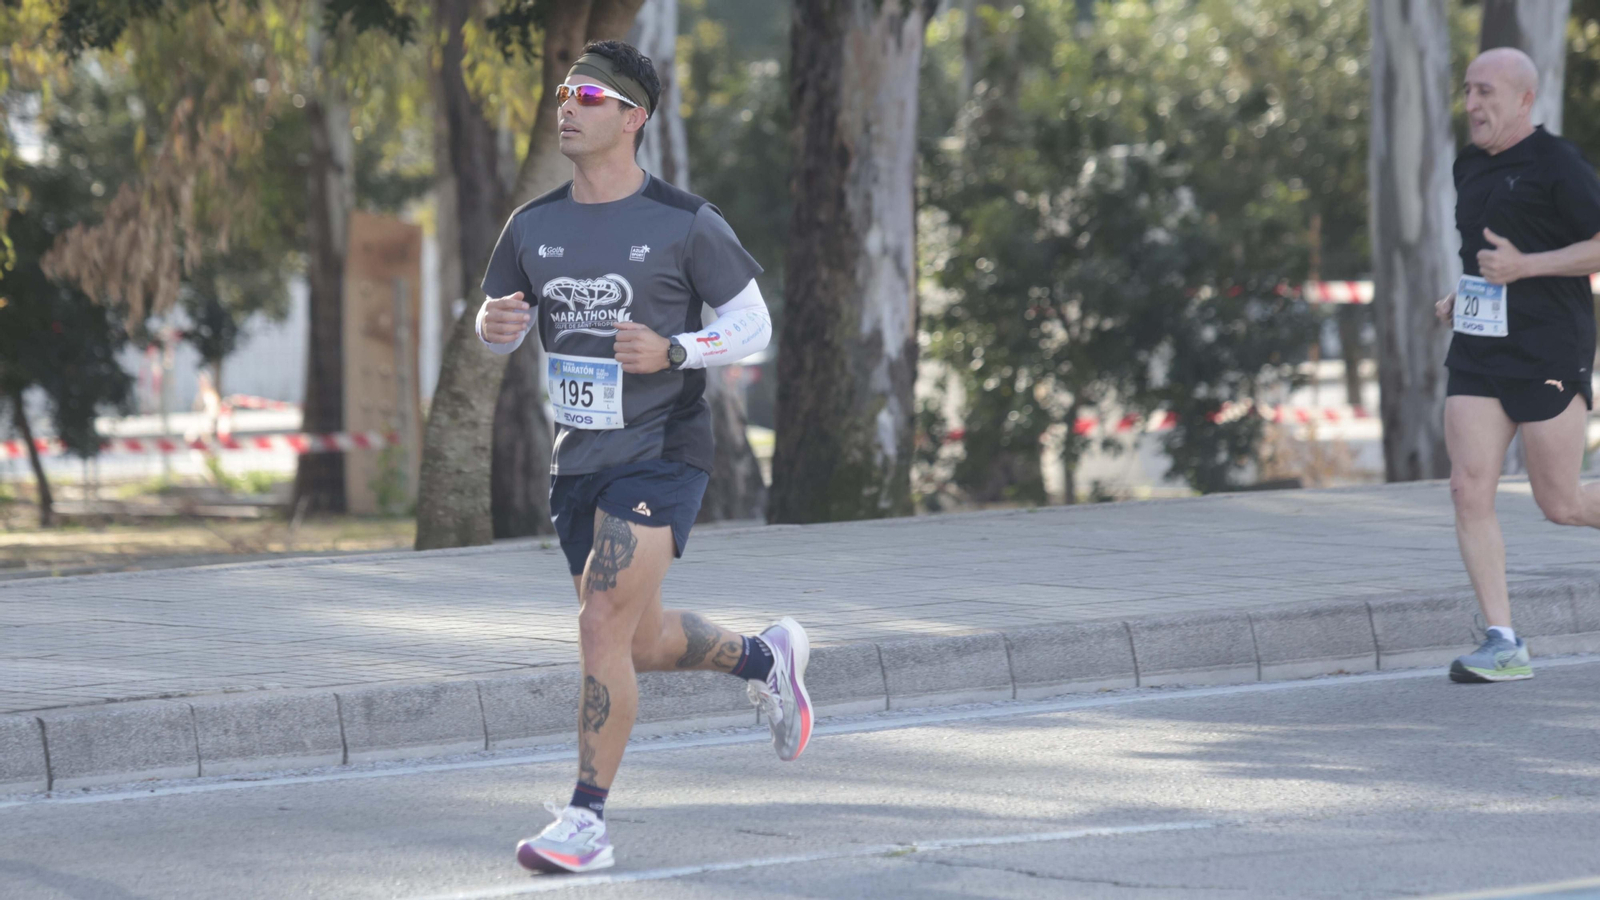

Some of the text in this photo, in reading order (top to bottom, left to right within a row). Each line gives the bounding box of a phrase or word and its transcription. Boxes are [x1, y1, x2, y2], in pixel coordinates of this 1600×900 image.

[1464, 295, 1480, 317] 20
[550, 309, 617, 322] MARATHON
[562, 365, 594, 375] MARATÓN
[559, 378, 594, 408] 195
[564, 412, 594, 425] EVOS
